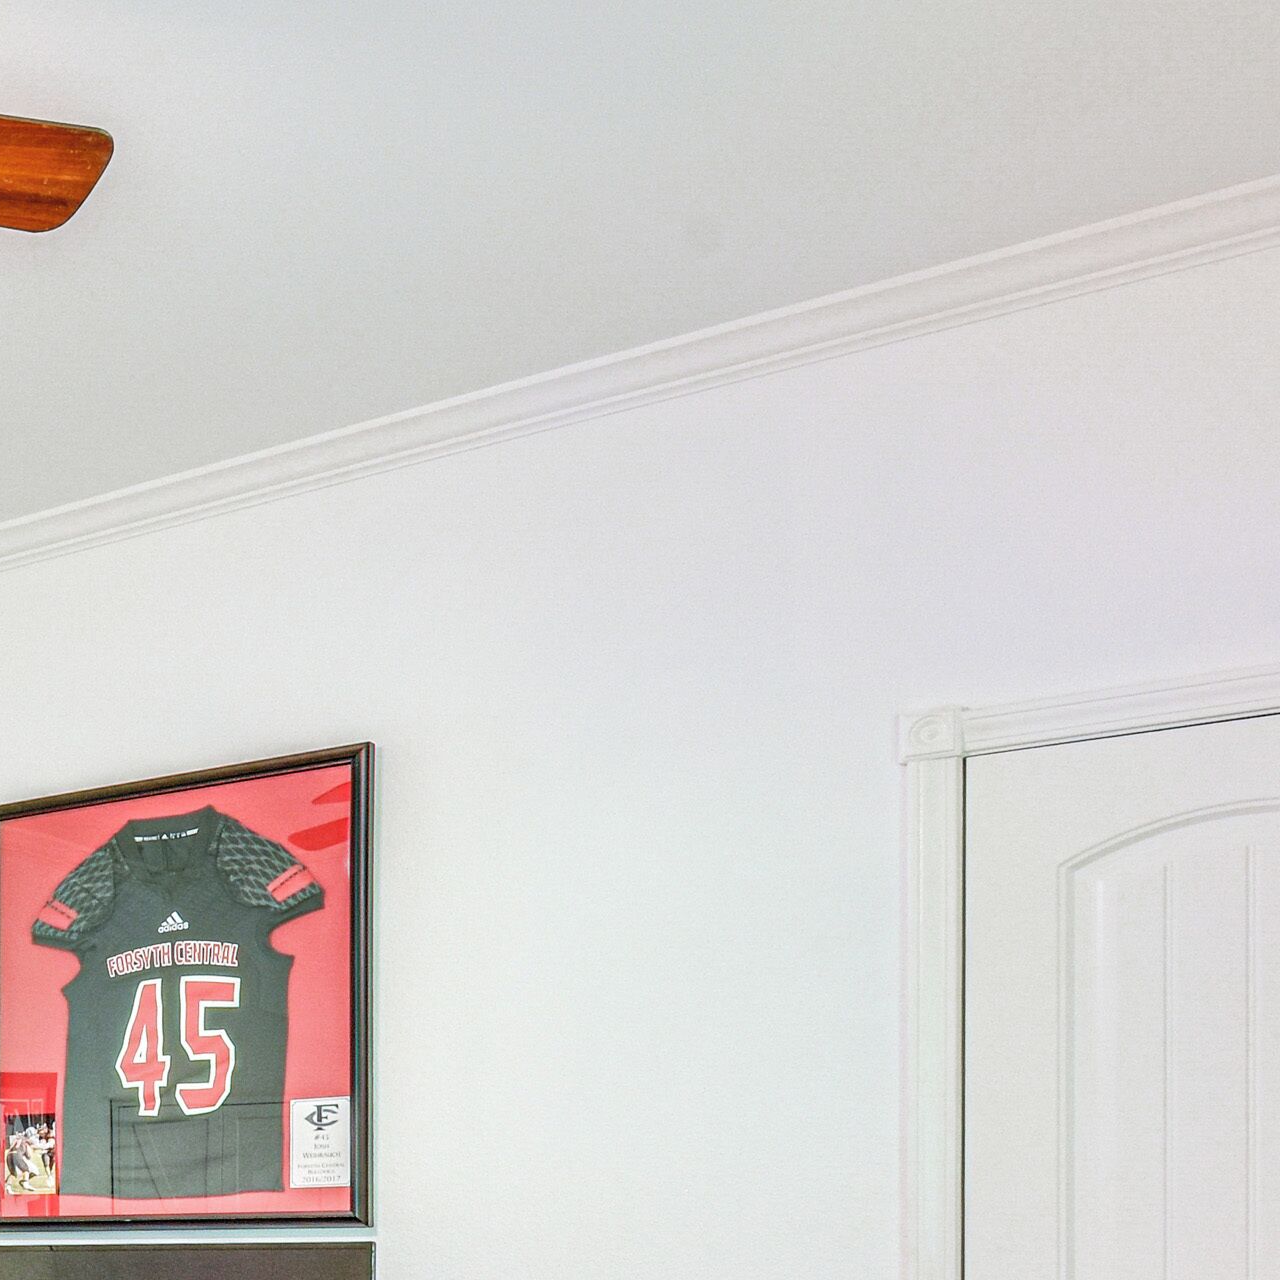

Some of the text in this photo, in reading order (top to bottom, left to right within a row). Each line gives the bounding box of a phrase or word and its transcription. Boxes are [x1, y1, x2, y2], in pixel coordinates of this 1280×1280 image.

[157, 921, 190, 934] adidas
[106, 940, 239, 978] FORSYTH CENTRAL
[115, 975, 241, 1117] 45
